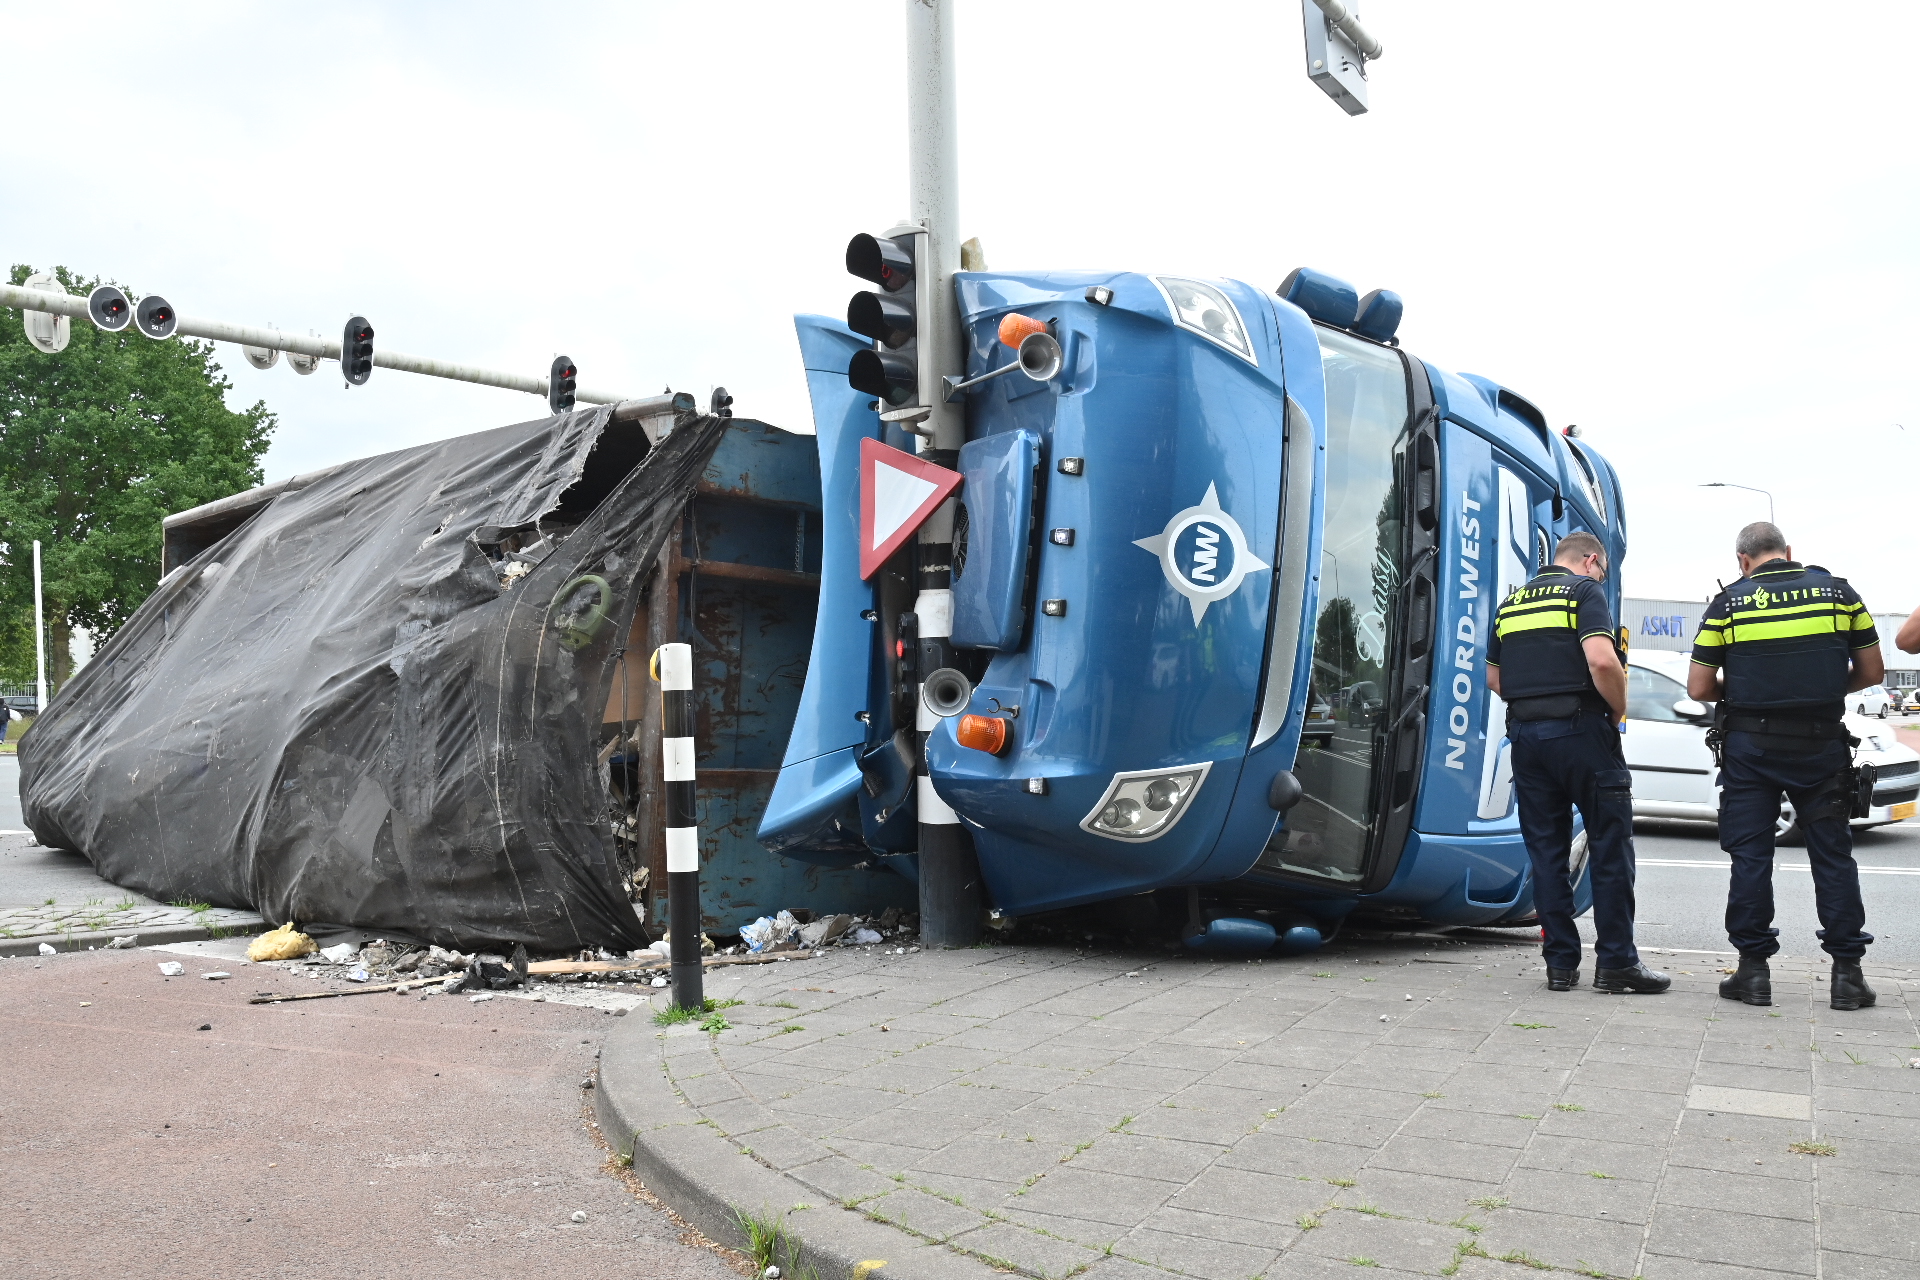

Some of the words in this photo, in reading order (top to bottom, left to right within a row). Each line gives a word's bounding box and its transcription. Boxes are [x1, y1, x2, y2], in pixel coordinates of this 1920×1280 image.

[1191, 524, 1220, 582] NW
[1356, 547, 1400, 669] Daisy
[1507, 585, 1562, 605] POLITIE
[1743, 586, 1821, 609] POLITIE
[1444, 491, 1481, 770] NOORD-WEST
